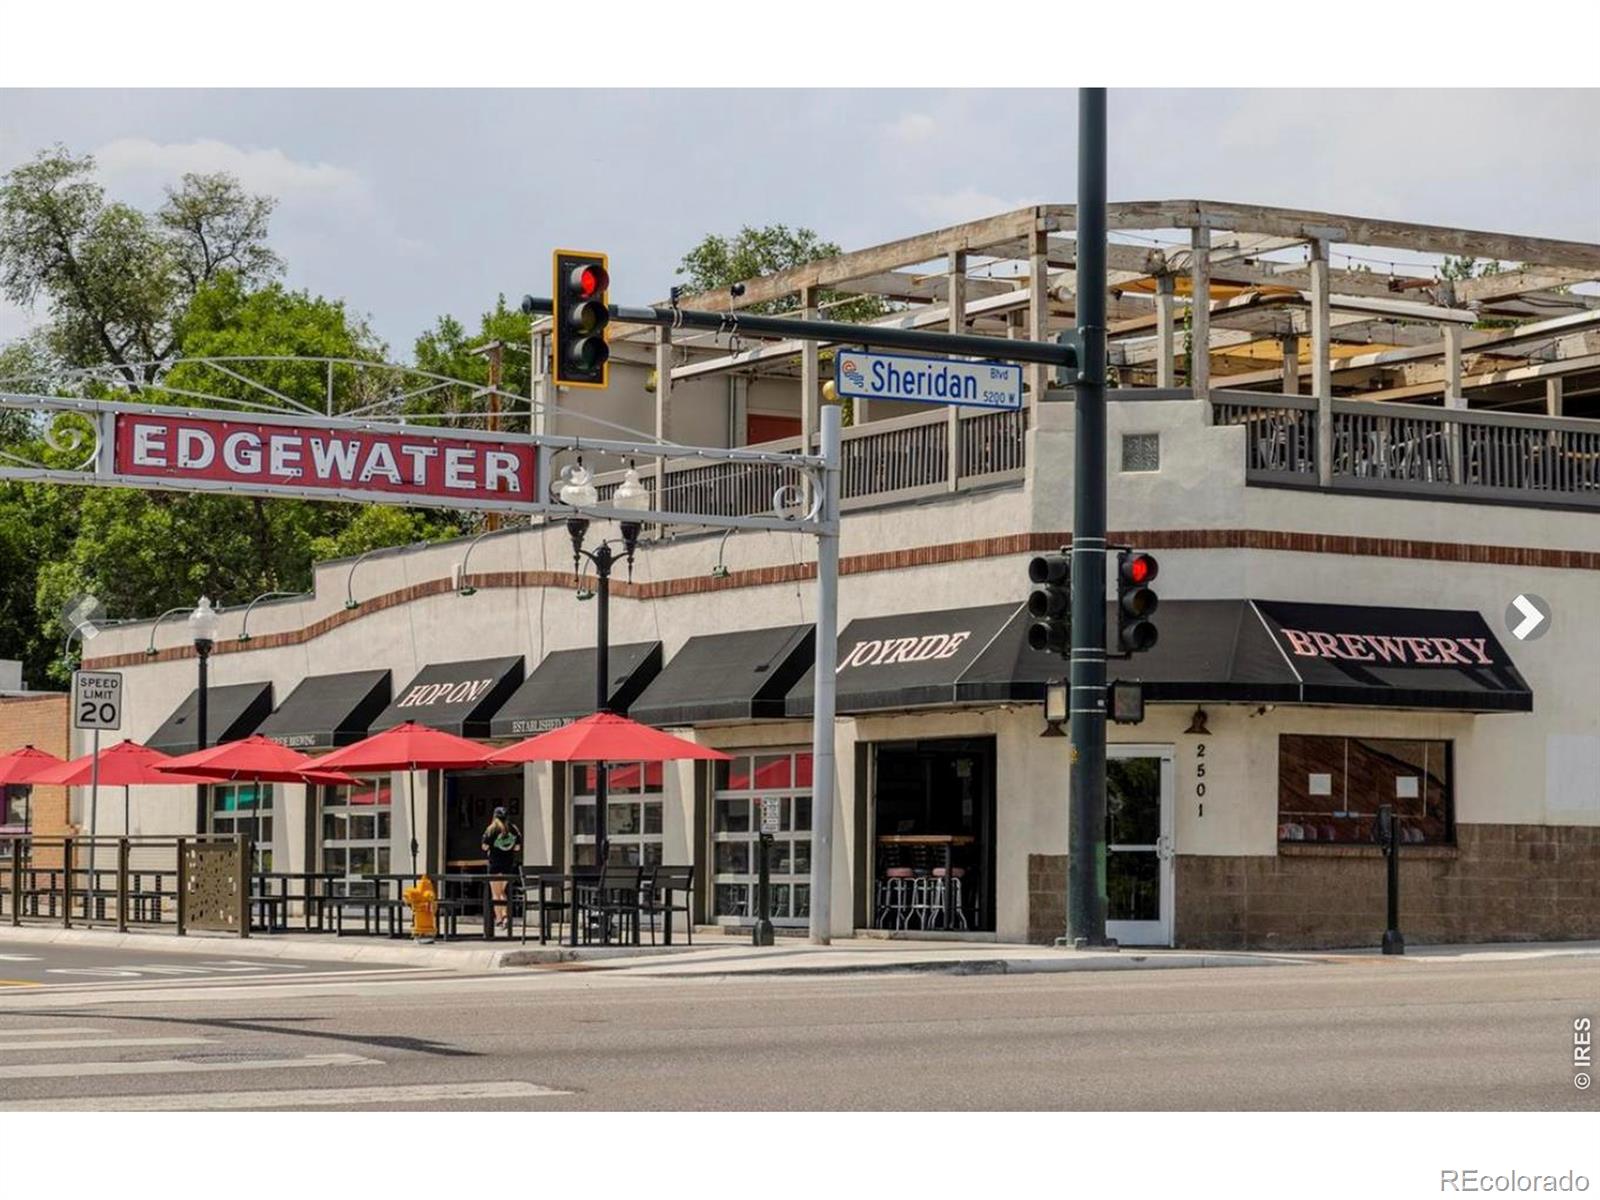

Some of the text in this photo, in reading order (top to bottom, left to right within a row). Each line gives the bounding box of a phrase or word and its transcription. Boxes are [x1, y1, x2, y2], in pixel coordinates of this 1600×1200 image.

[871, 360, 977, 400] Sheridan
[990, 367, 1009, 381] Blvd
[983, 391, 1015, 404] 5200 W
[133, 422, 522, 494] EDGEWATER
[835, 630, 972, 674] JOYRIDE
[1281, 628, 1494, 665] BREWERY
[80, 677, 119, 689] SPEED
[83, 689, 113, 700] LIMIT
[397, 683, 454, 708] HOP
[80, 701, 116, 724] 20
[1196, 743, 1206, 818] 2501
